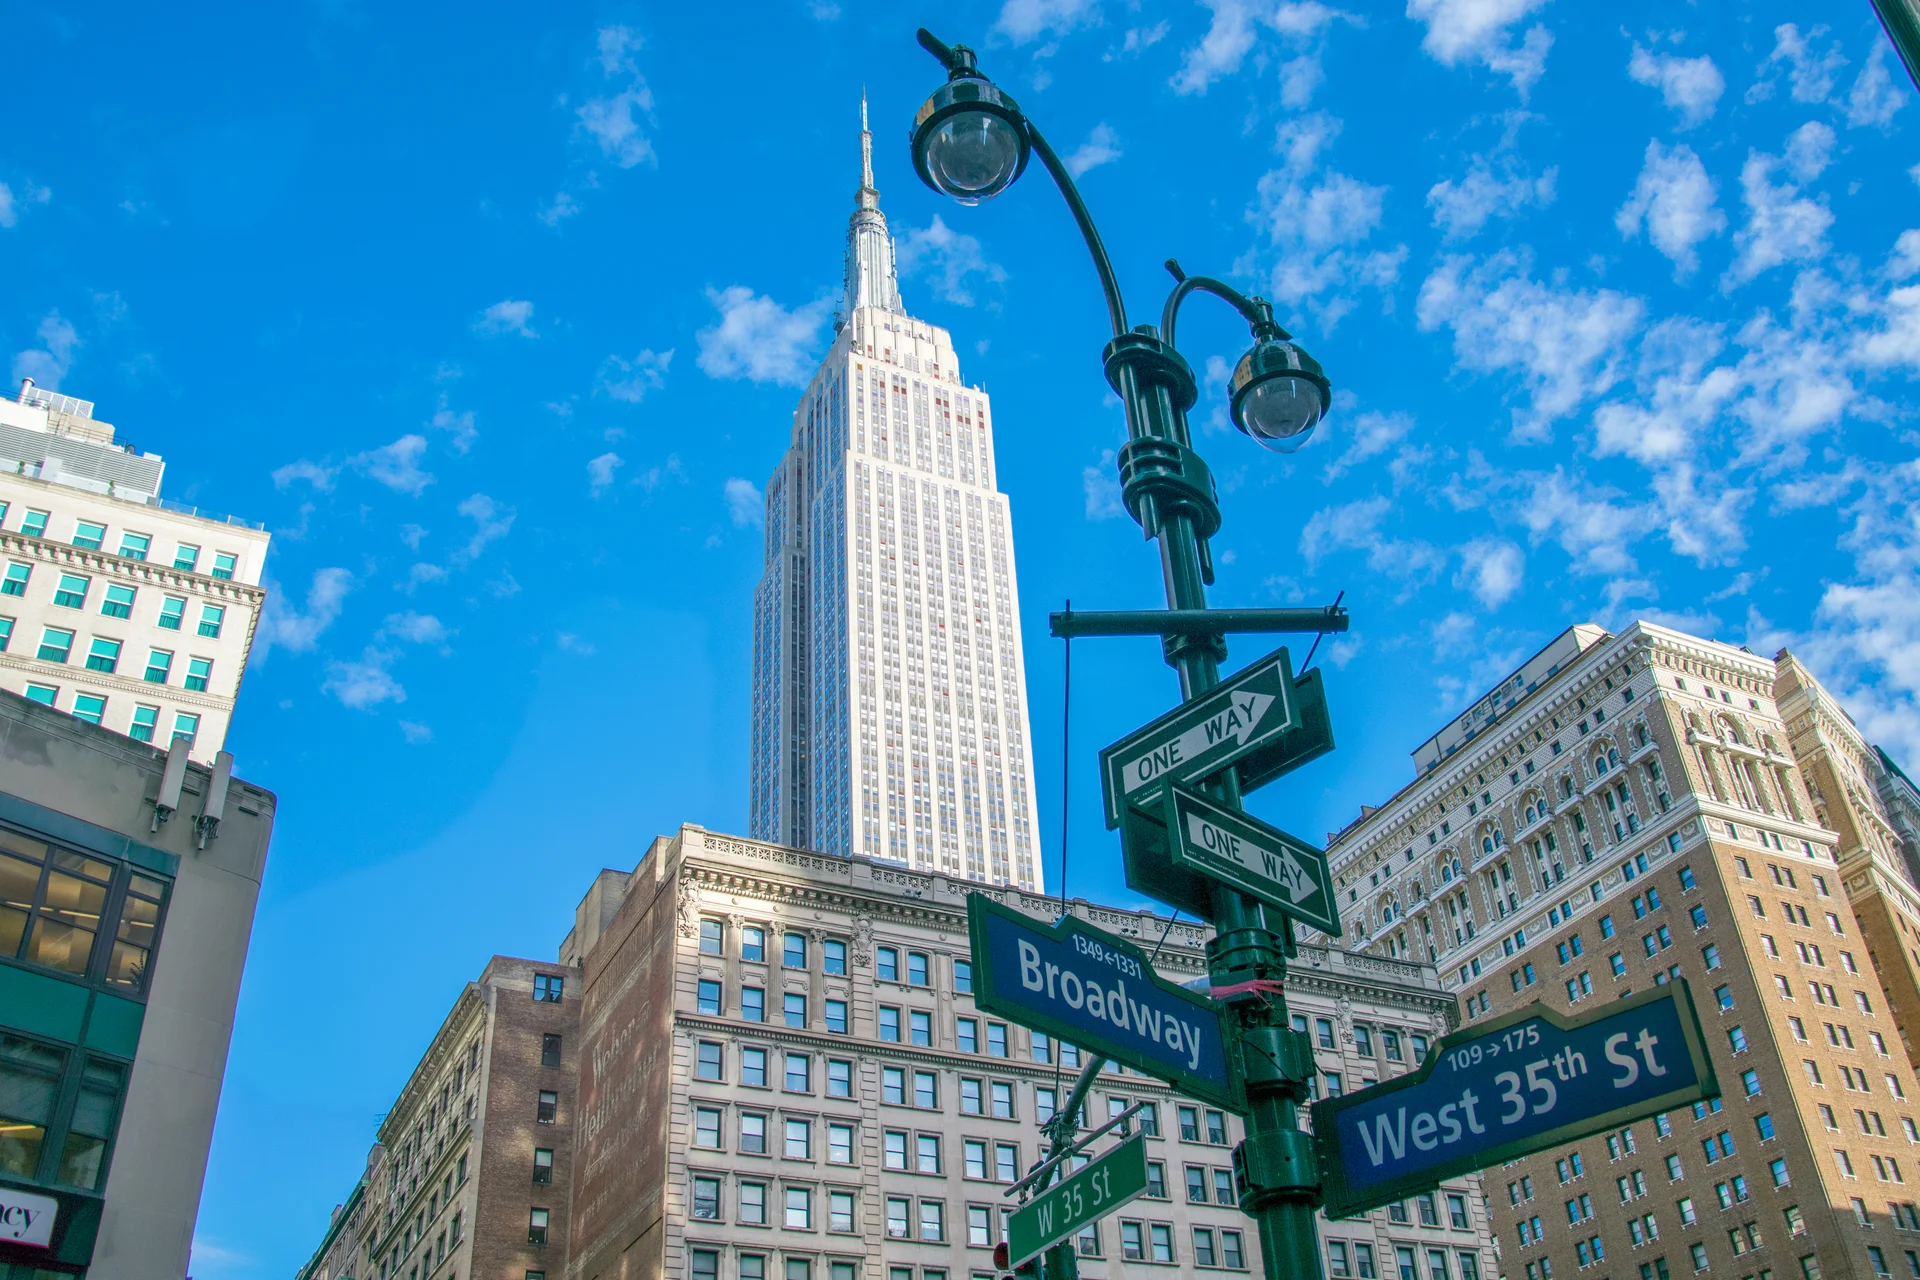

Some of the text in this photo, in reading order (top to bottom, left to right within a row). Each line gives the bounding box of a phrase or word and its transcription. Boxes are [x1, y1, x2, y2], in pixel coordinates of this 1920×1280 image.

[1138, 696, 1256, 782] ONE WAY
[1202, 823, 1244, 864] ONE
[1260, 850, 1303, 891] WAY
[1072, 933, 1143, 980] 1349 1331
[1017, 938, 1201, 1070] Broadway
[1448, 1024, 1540, 1072] 109 175
[1357, 1028, 1667, 1167] West 35th St
[0, 1204, 41, 1238] cy
[1037, 1165, 1111, 1238] W 35 St
